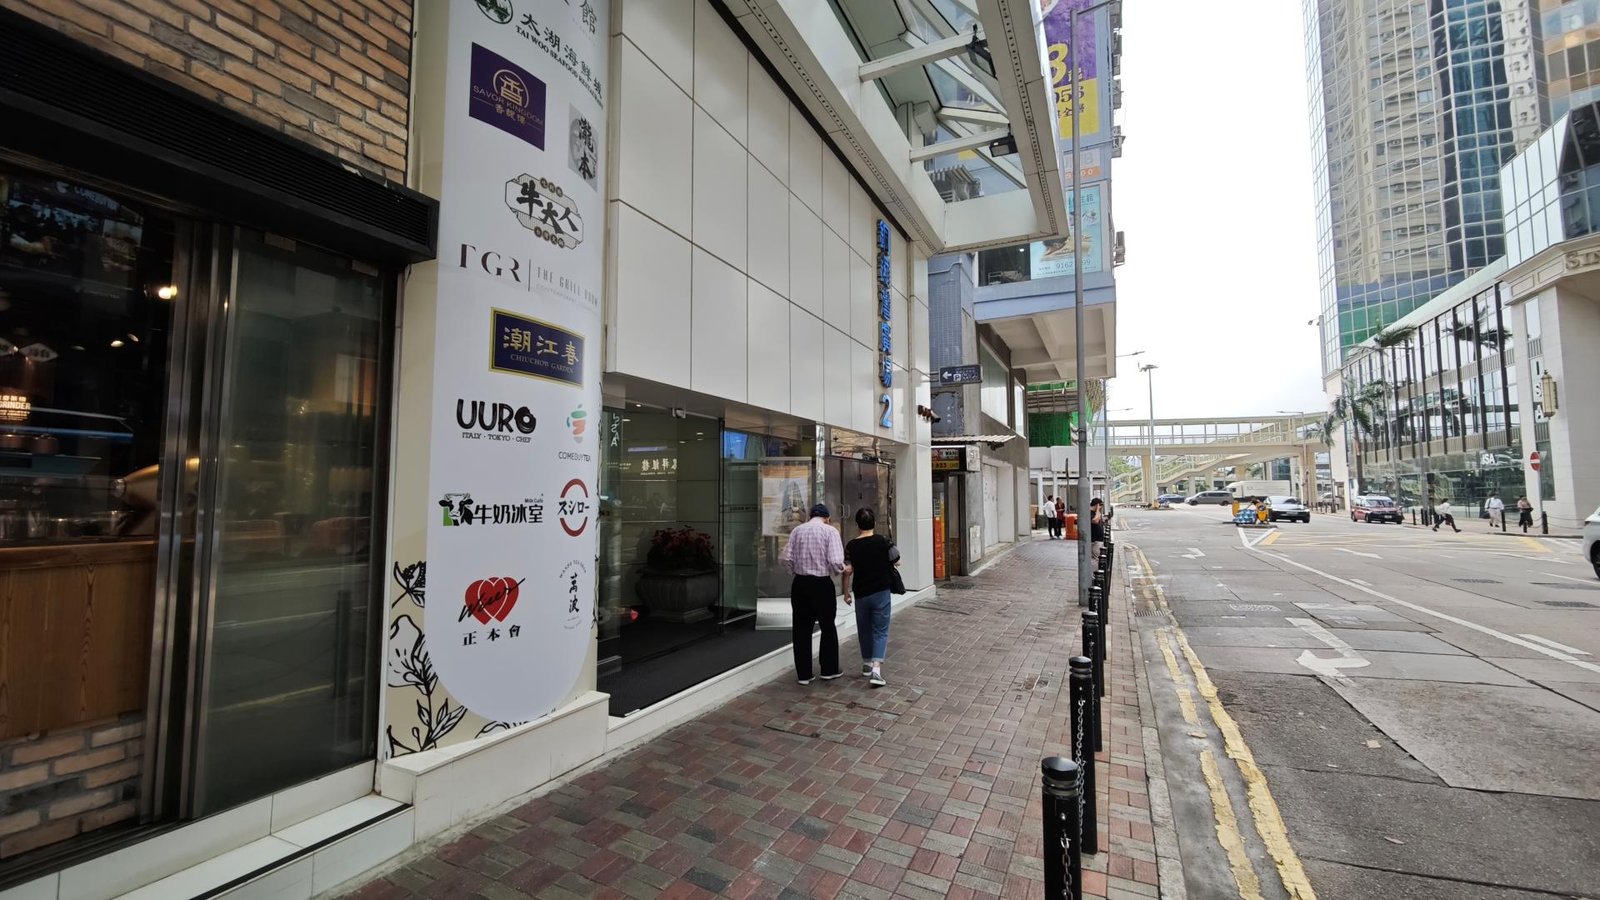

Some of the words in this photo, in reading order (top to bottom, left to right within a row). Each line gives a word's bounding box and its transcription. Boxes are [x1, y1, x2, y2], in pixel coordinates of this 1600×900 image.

[515, 25, 529, 39] TAI
[530, 35, 549, 53] WOO
[550, 50, 578, 78] SEAFOOD
[473, 84, 505, 105] SAVOR
[506, 101, 544, 126] KINGDOM
[516, 179, 579, 235] 牛大人
[537, 266, 553, 283] THE
[559, 276, 581, 297] GRILL
[502, 326, 579, 365] 潮江春
[510, 354, 550, 367] CHIUCHOW
[550, 361, 574, 374] GARDEN
[456, 398, 537, 435] UURO
[461, 432, 482, 440] ITALY
[488, 434, 511, 442] TOKYO
[515, 435, 532, 443] CHEF
[558, 451, 592, 463] COMEBUYTEA
[474, 504, 543, 525] 牛奶冰室
[557, 501, 590, 516] スシロー
[462, 624, 521, 646] 正本會
